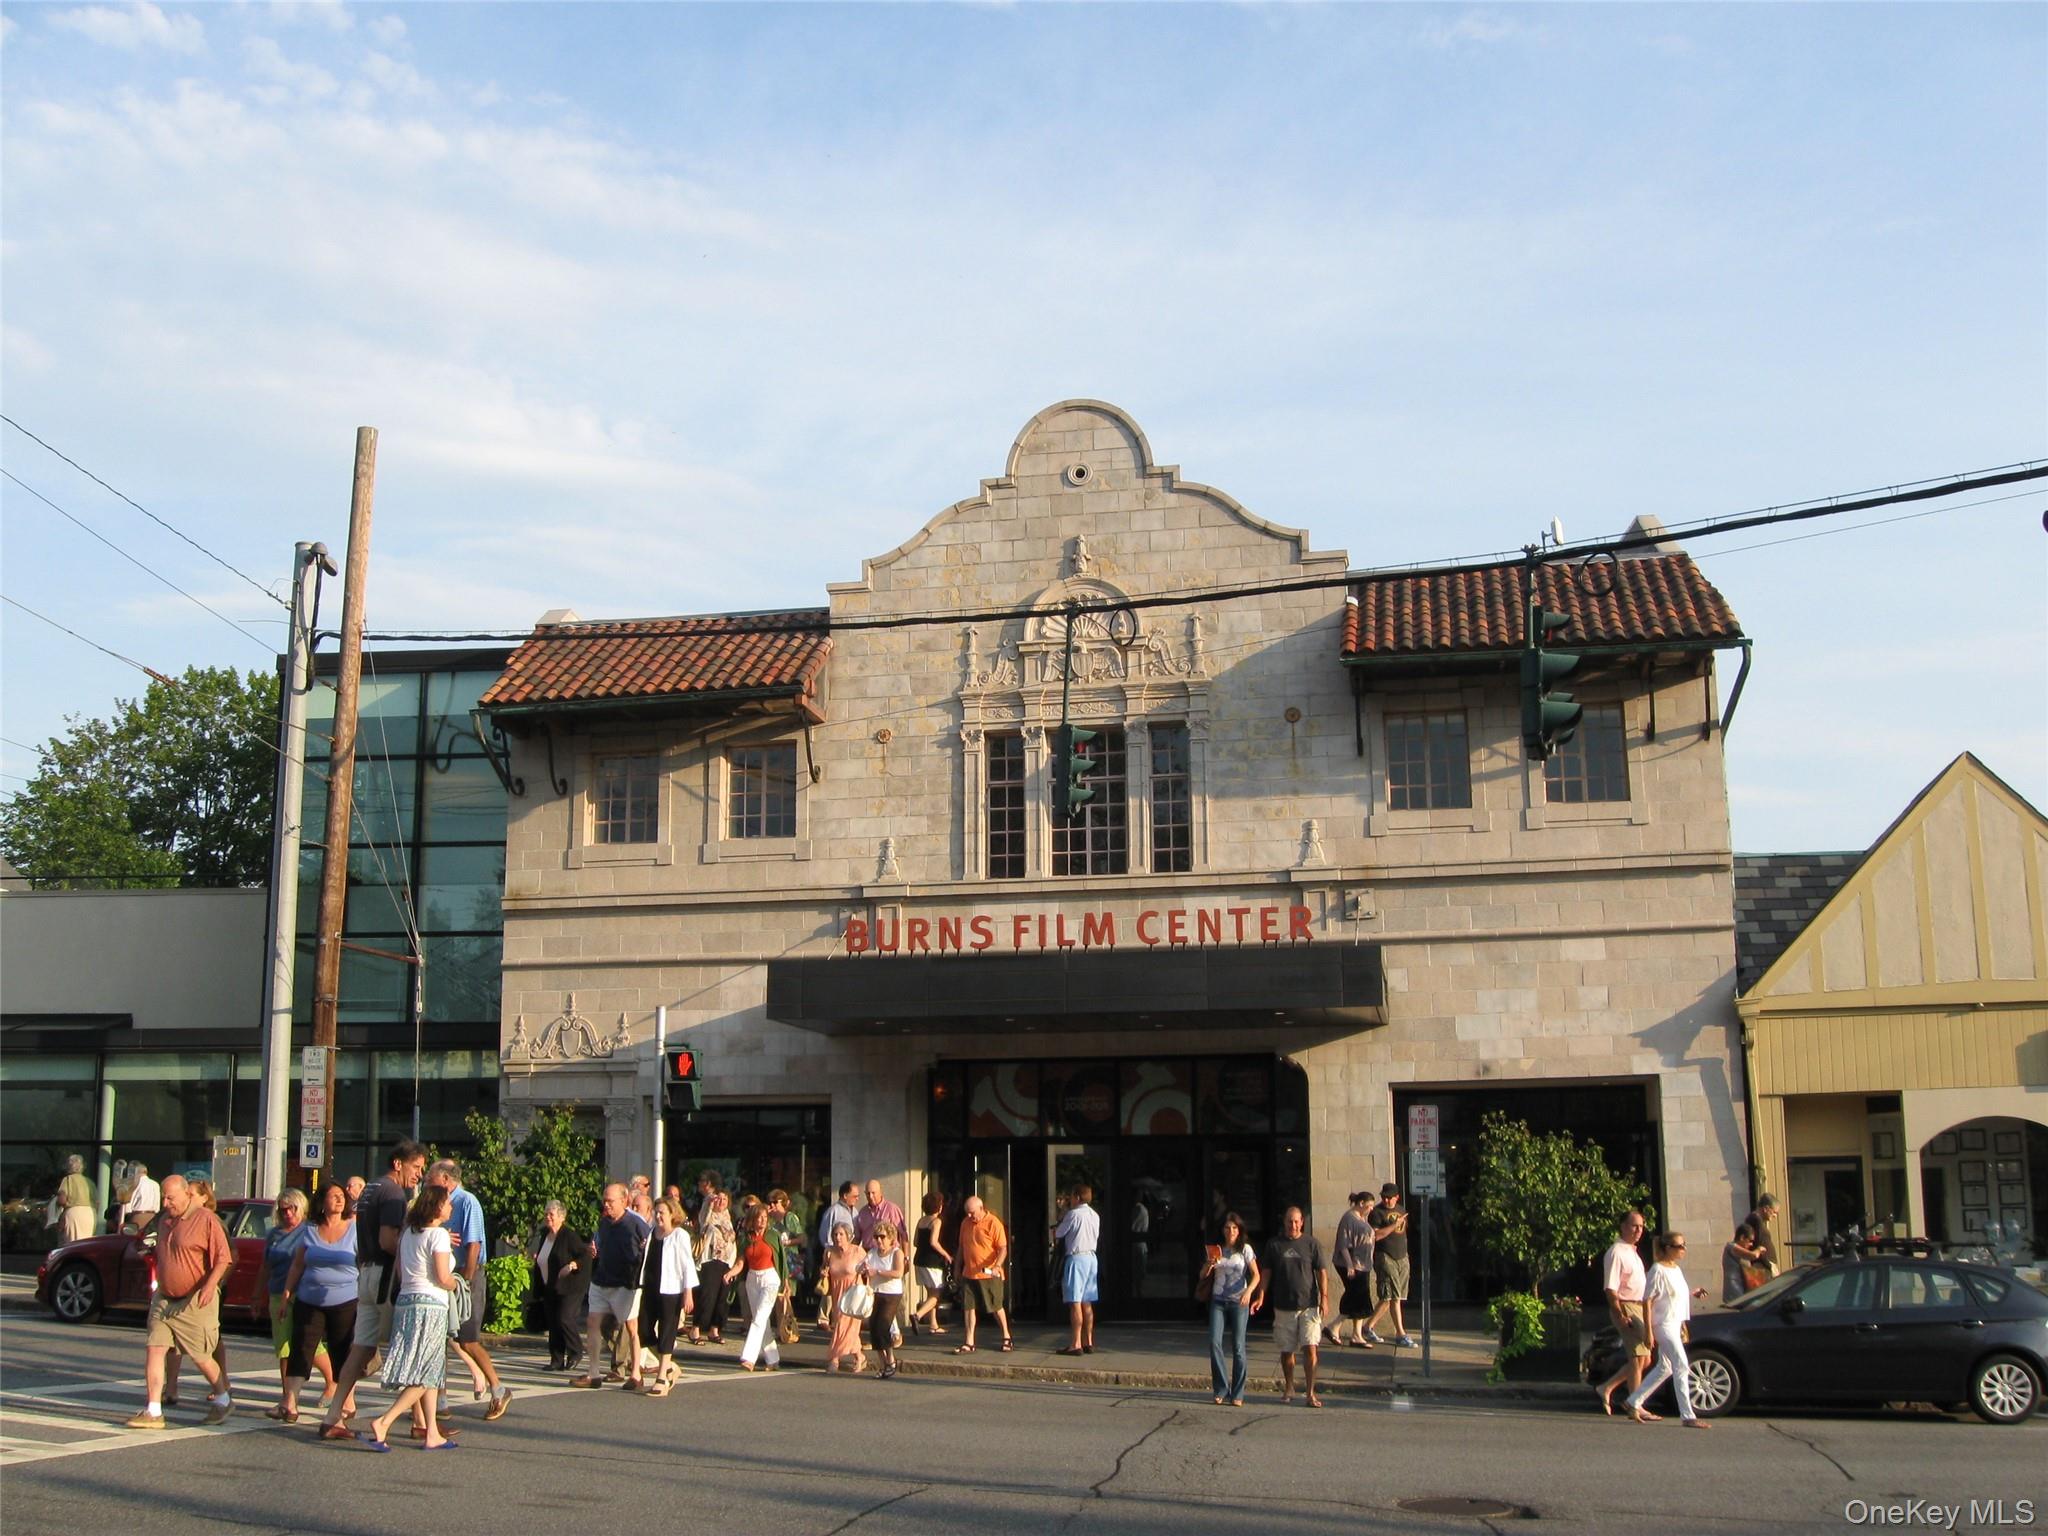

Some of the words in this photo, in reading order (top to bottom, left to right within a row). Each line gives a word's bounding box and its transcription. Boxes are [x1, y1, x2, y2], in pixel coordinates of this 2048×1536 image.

[846, 916, 993, 952] BURNS
[1013, 912, 1116, 947] FILM
[1137, 906, 1313, 945] CENTER
